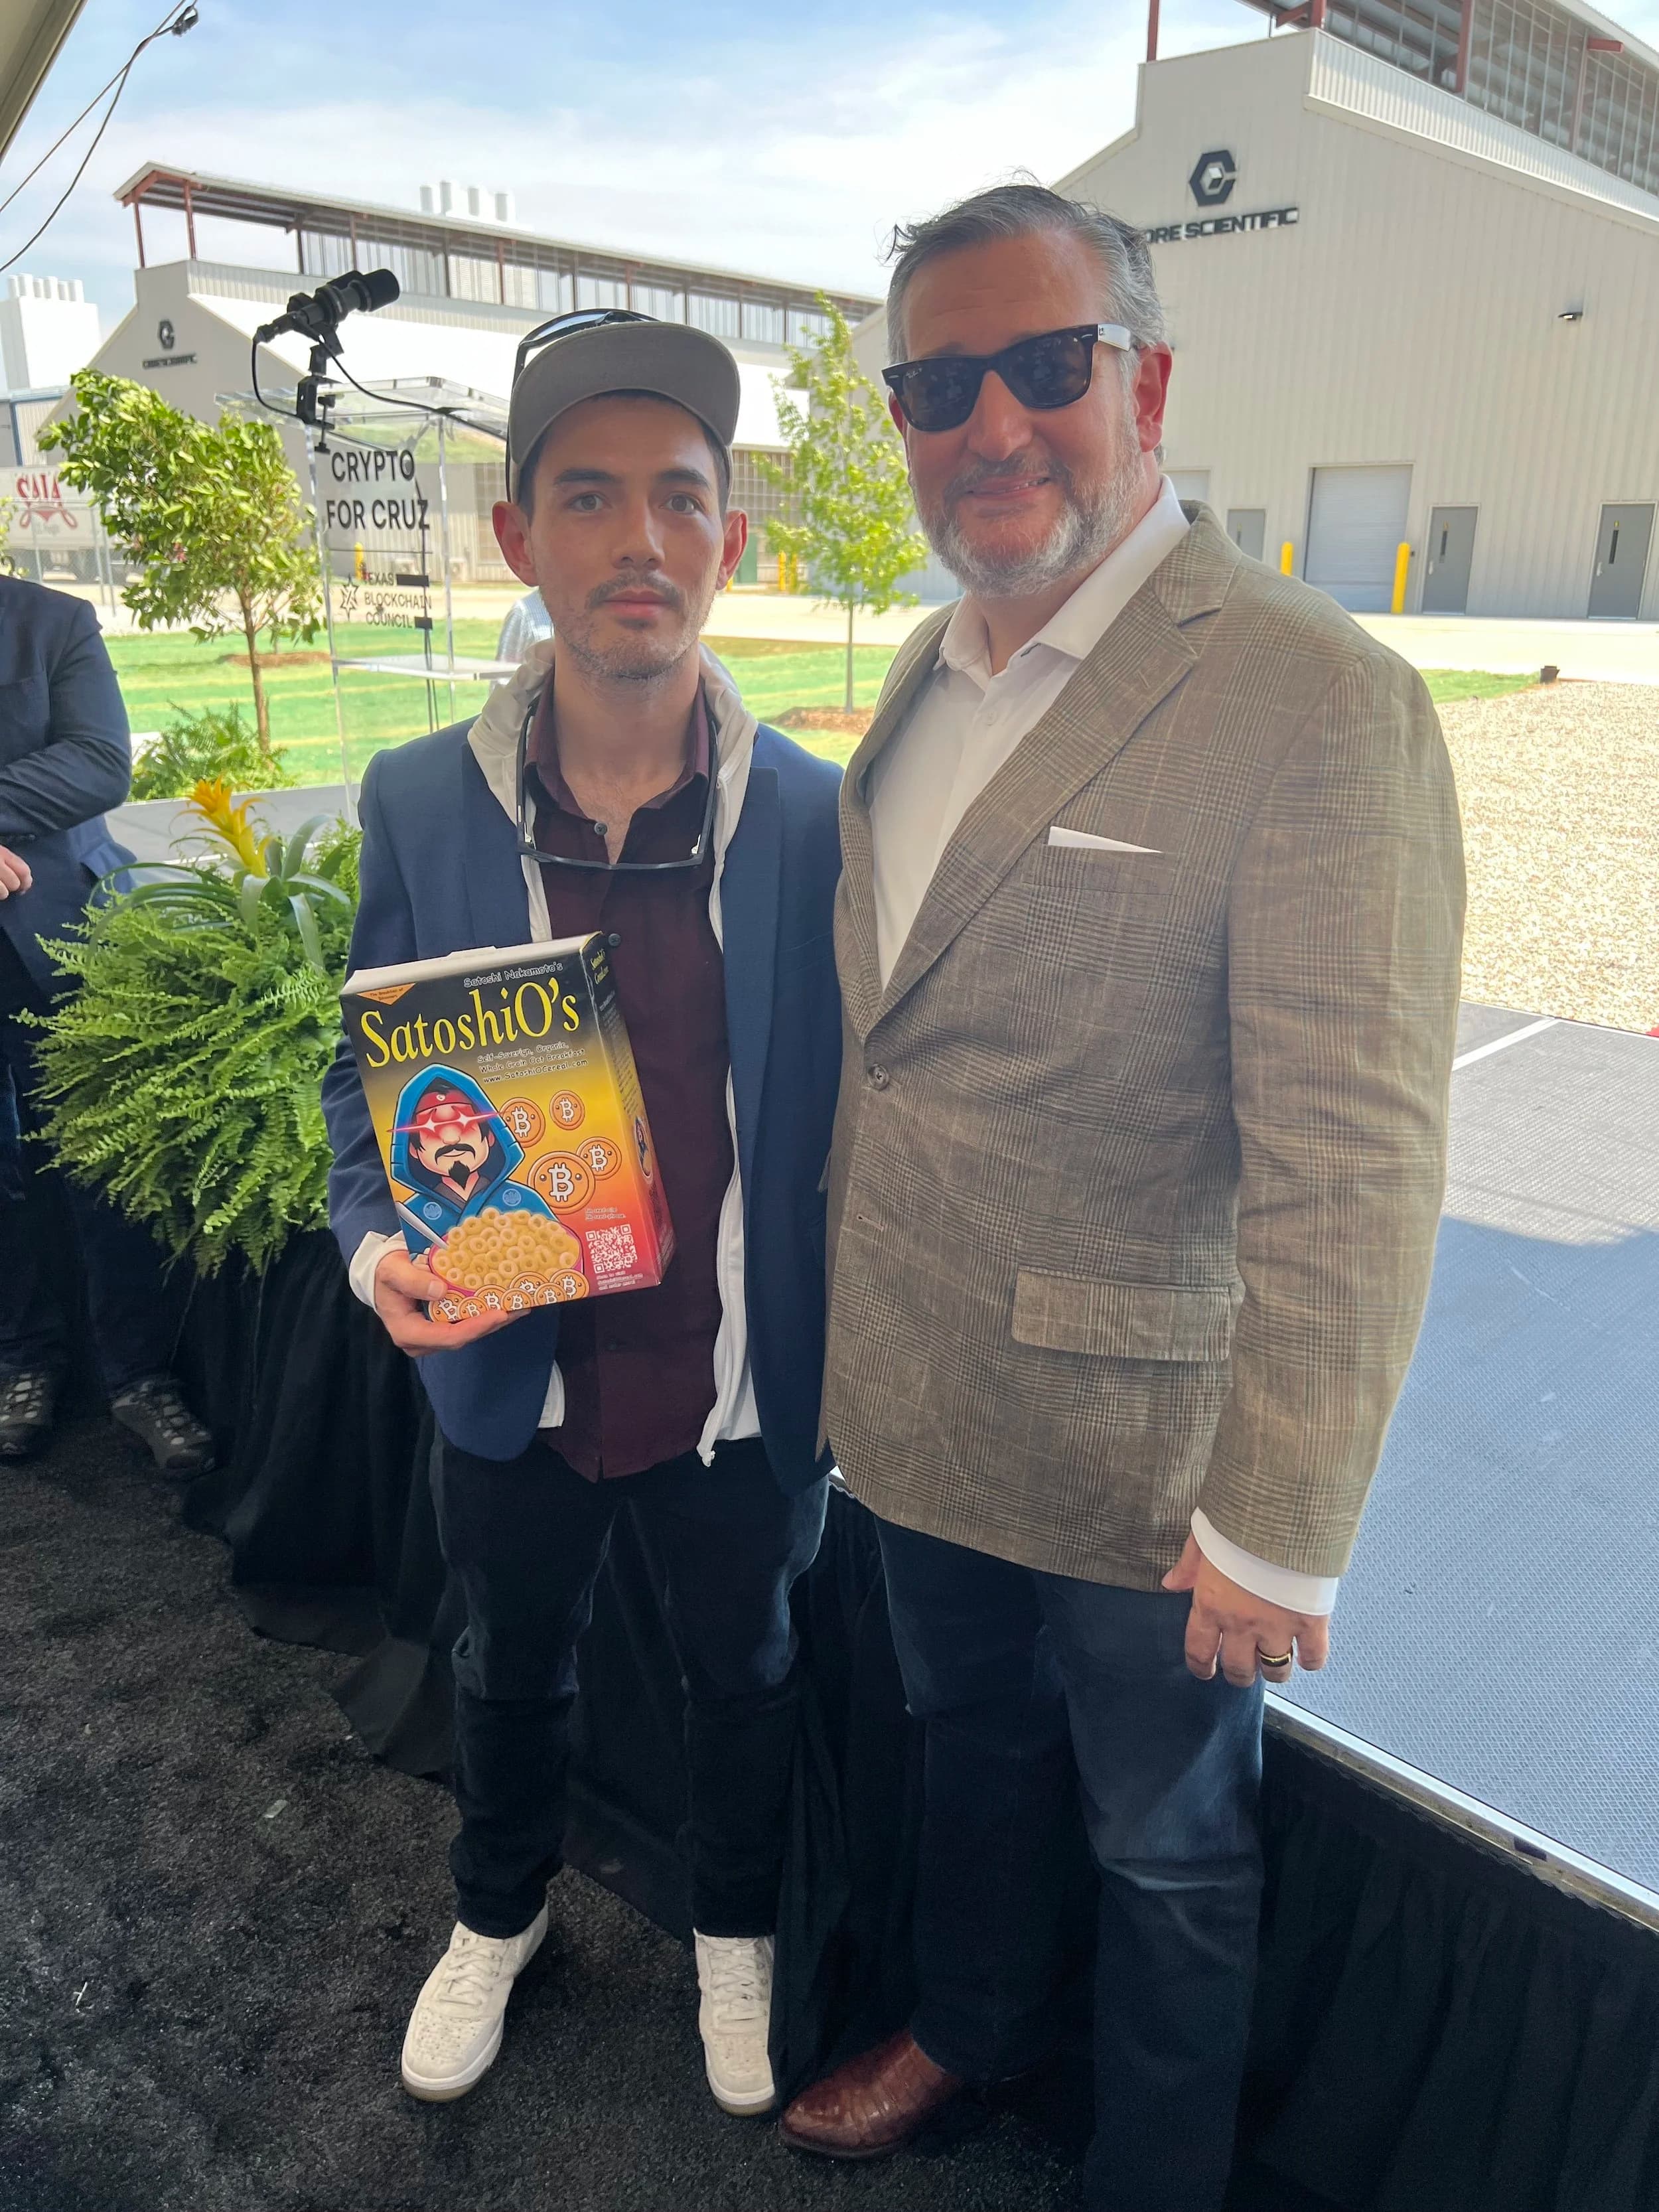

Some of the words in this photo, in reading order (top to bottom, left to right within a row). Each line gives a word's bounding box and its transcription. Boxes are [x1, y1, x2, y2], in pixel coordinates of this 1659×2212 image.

[1145, 224, 1181, 244] ORE
[1185, 207, 1299, 239] SCIENTIFIC
[332, 449, 415, 482] CRYPTO
[326, 499, 366, 530] FOR
[372, 499, 431, 530] CRUZ
[364, 591, 432, 609] BLOCKCHAIN
[366, 611, 413, 628] COUNCIL
[463, 972, 502, 988] Satoshi
[504, 961, 563, 981] Nakamoto's
[359, 976, 580, 1069] SatoshiO's
[479, 1063, 504, 1074] Whole
[506, 1059, 527, 1069] Grain
[530, 1055, 544, 1065] Oat
[547, 1048, 585, 1062] Breakfast
